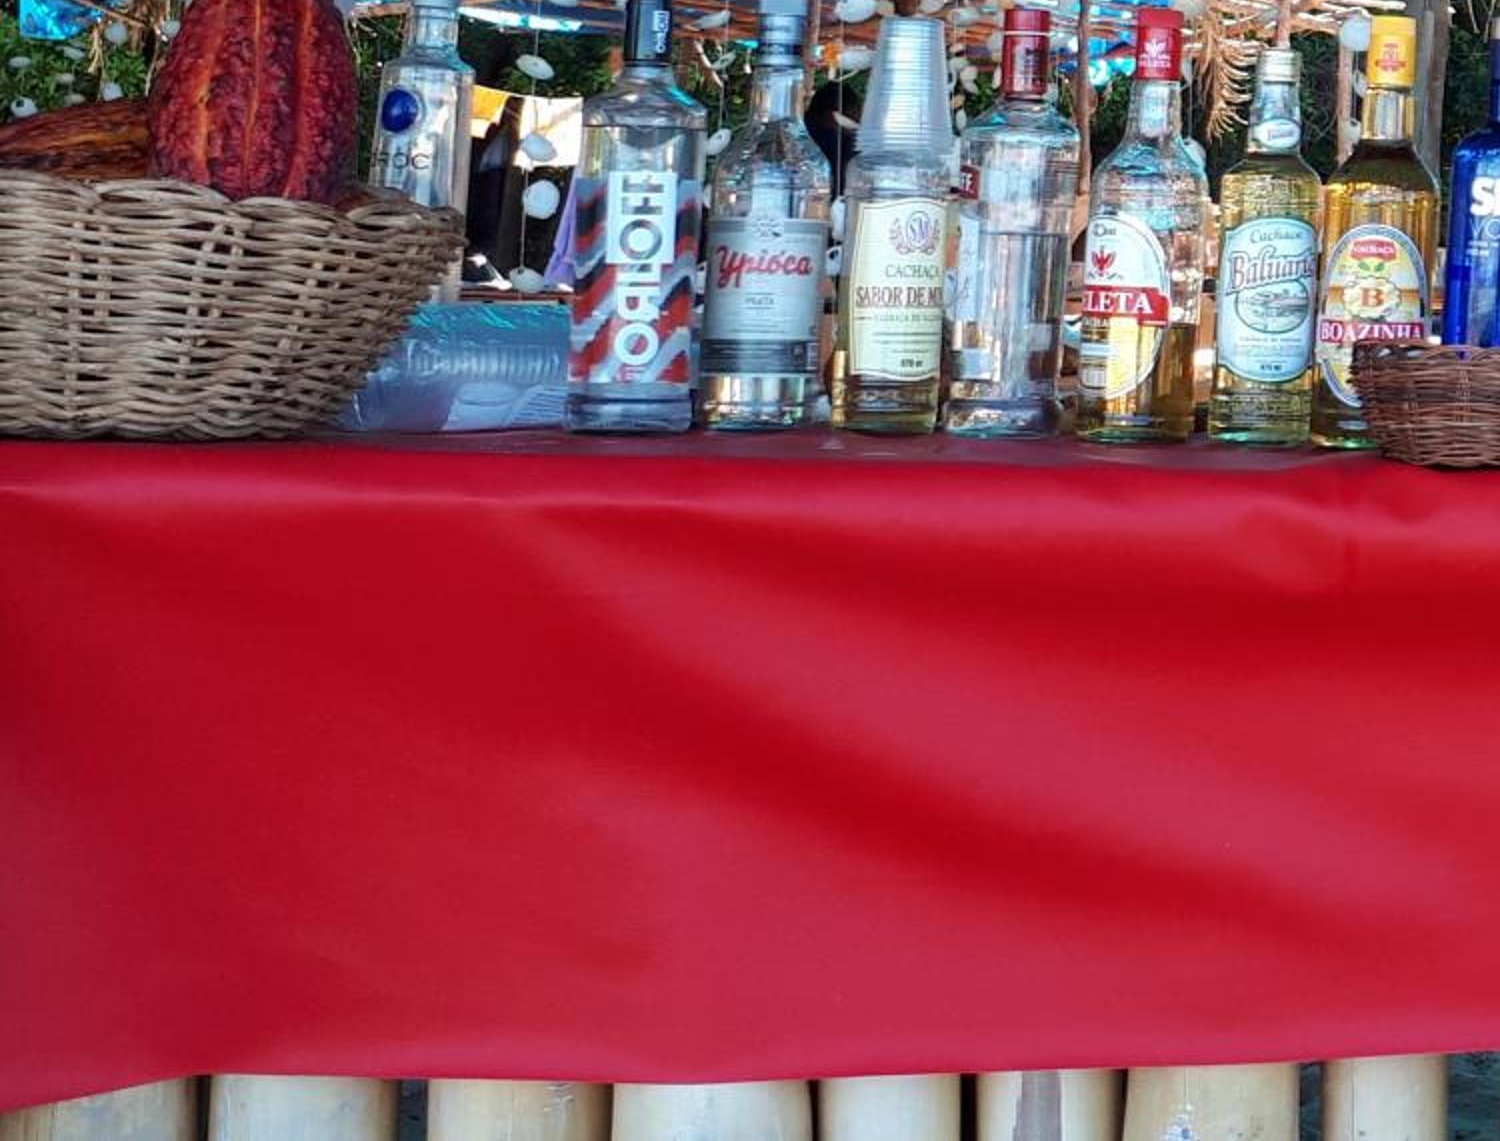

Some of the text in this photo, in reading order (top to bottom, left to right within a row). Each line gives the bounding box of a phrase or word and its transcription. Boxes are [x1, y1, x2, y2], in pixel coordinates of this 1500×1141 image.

[856, 287, 902, 307] SABOR
[906, 287, 926, 308] DE
[1321, 320, 1422, 343] BOAZINHA
